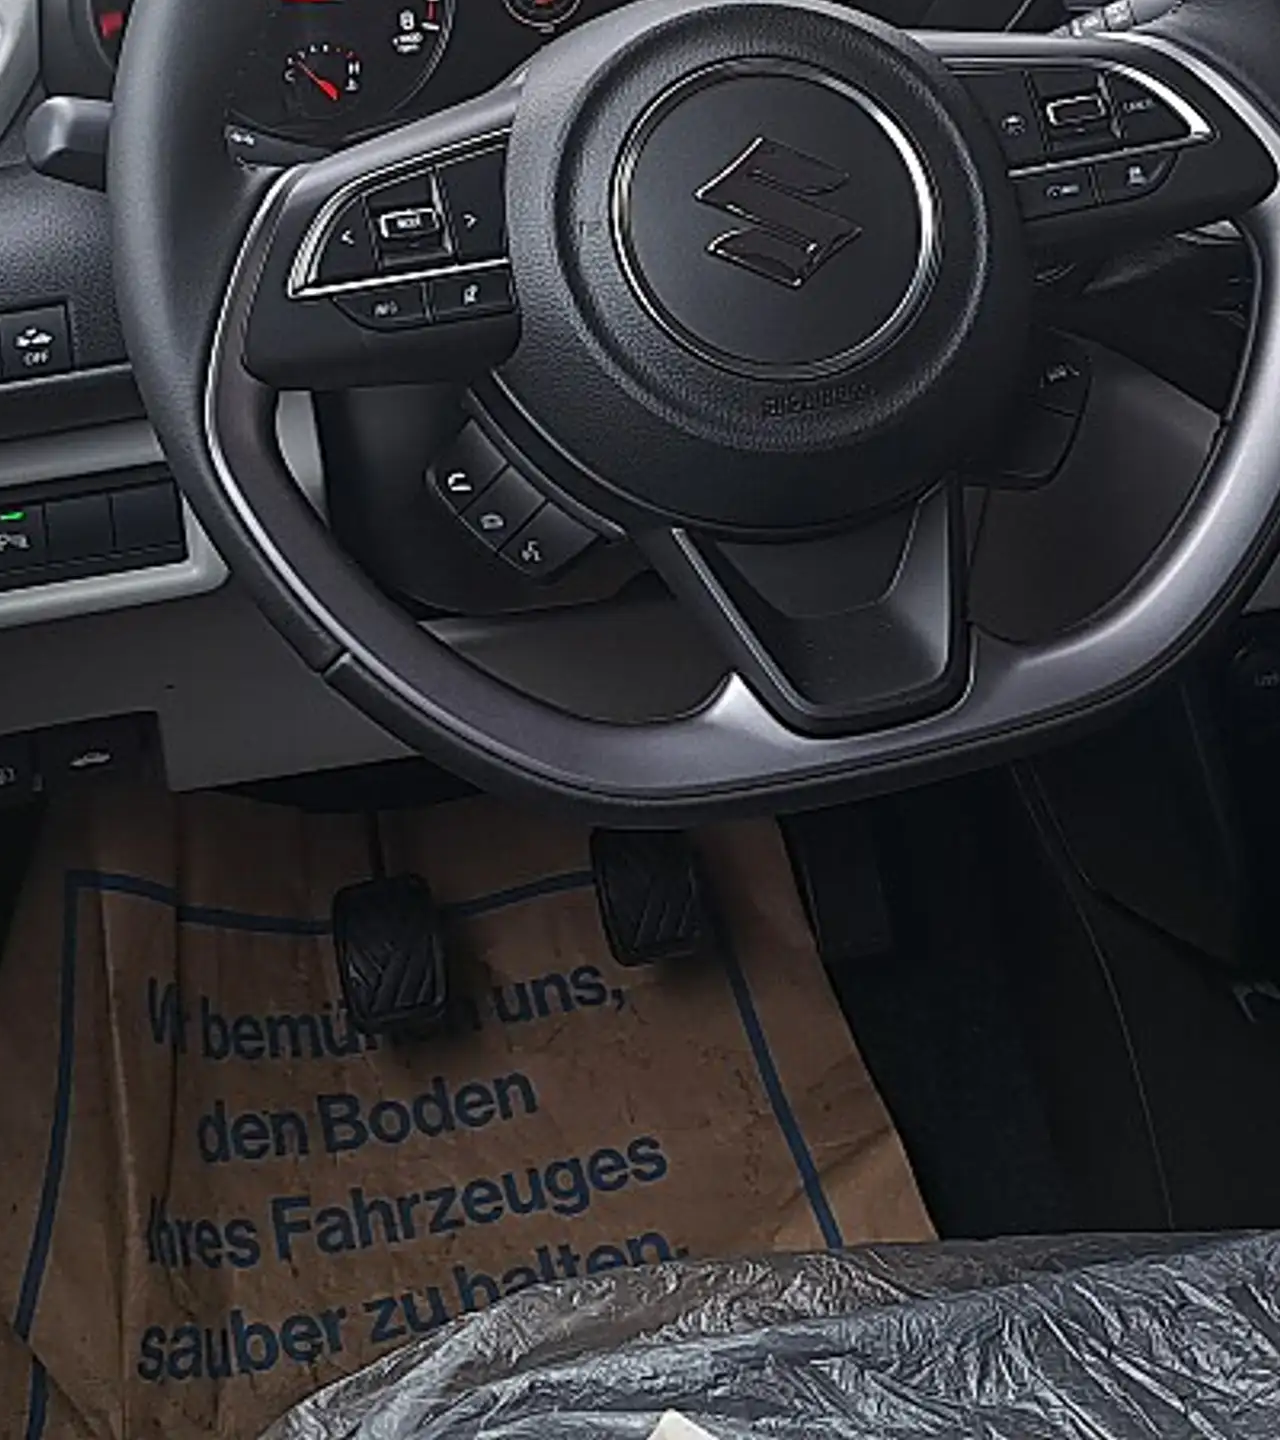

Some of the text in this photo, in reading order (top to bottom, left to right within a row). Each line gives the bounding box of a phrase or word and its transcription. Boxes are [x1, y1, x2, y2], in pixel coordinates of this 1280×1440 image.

[400, 10, 415, 31] 8
[24, 350, 49, 366] OFF
[492, 963, 626, 1024] uns,
[196, 1067, 540, 1164] den Boden
[146, 1134, 669, 1268] Ihres Fahrzeuges
[137, 1307, 347, 1381] sauber
[365, 1285, 457, 1344] zu
